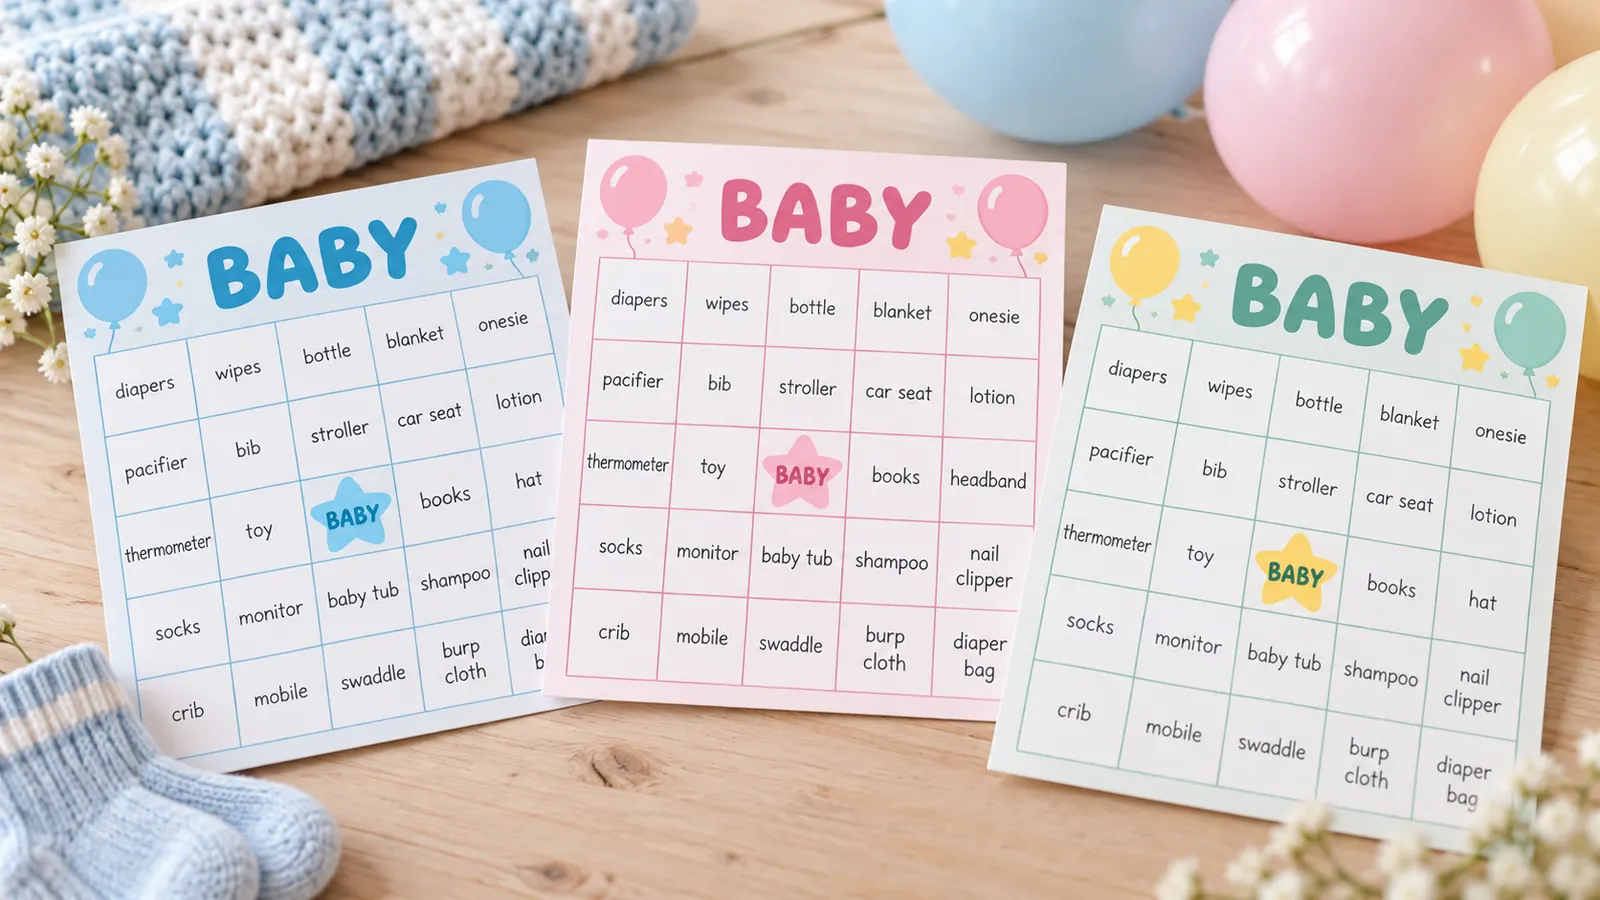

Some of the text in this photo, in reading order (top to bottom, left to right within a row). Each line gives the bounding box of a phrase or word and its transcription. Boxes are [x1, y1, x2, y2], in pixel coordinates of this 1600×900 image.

[720, 178, 933, 250] BABY
[207, 216, 418, 310] BABY
[612, 288, 667, 311] diapers
[706, 296, 748, 315] wipes
[790, 297, 835, 315] bottle
[874, 301, 931, 320] blanket
[1231, 262, 1450, 356] BABY
[479, 311, 528, 332] onesie
[970, 309, 1019, 324] onesie
[386, 325, 443, 349] blanket
[303, 342, 351, 364] bottle
[215, 362, 261, 382] wipes
[603, 370, 663, 390] pacifier
[709, 373, 731, 391] bib
[1109, 359, 1167, 384] diapers
[116, 378, 174, 399] diapers
[780, 378, 836, 396] stroller
[866, 387, 932, 400] car seat
[971, 386, 1014, 404] lotion
[1209, 379, 1252, 400] wipes
[496, 391, 542, 409] lotion
[1296, 390, 1342, 413] bottle
[398, 403, 461, 427] car seat
[1381, 404, 1439, 430] blanket
[311, 420, 368, 443] stroller
[1476, 426, 1526, 444] onesie
[236, 438, 260, 457] bib
[1089, 445, 1153, 465] pacifier
[125, 455, 187, 484] pacifier
[587, 452, 669, 472] thermometer
[701, 458, 726, 479] toy
[1203, 458, 1227, 478] bib
[515, 470, 541, 489] hat
[774, 464, 830, 487] BABY
[873, 465, 920, 484] books
[951, 468, 1026, 489] headband
[1279, 474, 1338, 496] stroller
[420, 486, 471, 509] books
[1367, 492, 1433, 512] car seat
[326, 502, 381, 531] BABY
[1471, 503, 1516, 527] lotion
[246, 523, 272, 540] toy
[1064, 523, 1152, 552] thermometer
[125, 535, 212, 563] thermometer
[524, 538, 550, 559] nail
[600, 536, 642, 555] socks
[677, 544, 739, 560] monitor
[971, 544, 998, 561] nail
[1188, 544, 1214, 568] toy
[762, 546, 832, 569] baby tub
[856, 550, 928, 574] shampoo
[421, 568, 490, 591] shampoo
[515, 567, 550, 588] clipp
[956, 568, 1013, 592] clipper
[1267, 560, 1325, 589] BABY
[1368, 572, 1415, 598] books
[328, 581, 398, 608] baby tub
[1469, 589, 1497, 611] hat
[239, 602, 303, 625] monitor
[1067, 614, 1113, 634] socks
[156, 618, 200, 640] socks
[599, 622, 629, 640] crib
[677, 626, 727, 645] mobile
[866, 624, 904, 649] burp
[442, 641, 479, 658] burp
[760, 634, 822, 653] swaddle
[954, 631, 1007, 655] diaper
[1156, 633, 1222, 654] monitor
[864, 651, 905, 671] cloth
[1248, 643, 1321, 671] baby tub
[342, 663, 405, 690] swaddle
[445, 661, 486, 684] cloth
[965, 658, 994, 683] bag
[1344, 659, 1418, 688] shampoo
[1461, 668, 1489, 685] nail
[255, 682, 308, 706] mobile
[1444, 689, 1501, 715] clipper
[172, 700, 204, 721] crib
[1058, 702, 1091, 721] crib
[1146, 720, 1201, 742] mobile
[1239, 737, 1305, 759] swaddle
[1350, 736, 1389, 765] burp
[1345, 766, 1388, 789] cloth
[1437, 755, 1492, 781] diaper
[1447, 784, 1478, 813] bag
